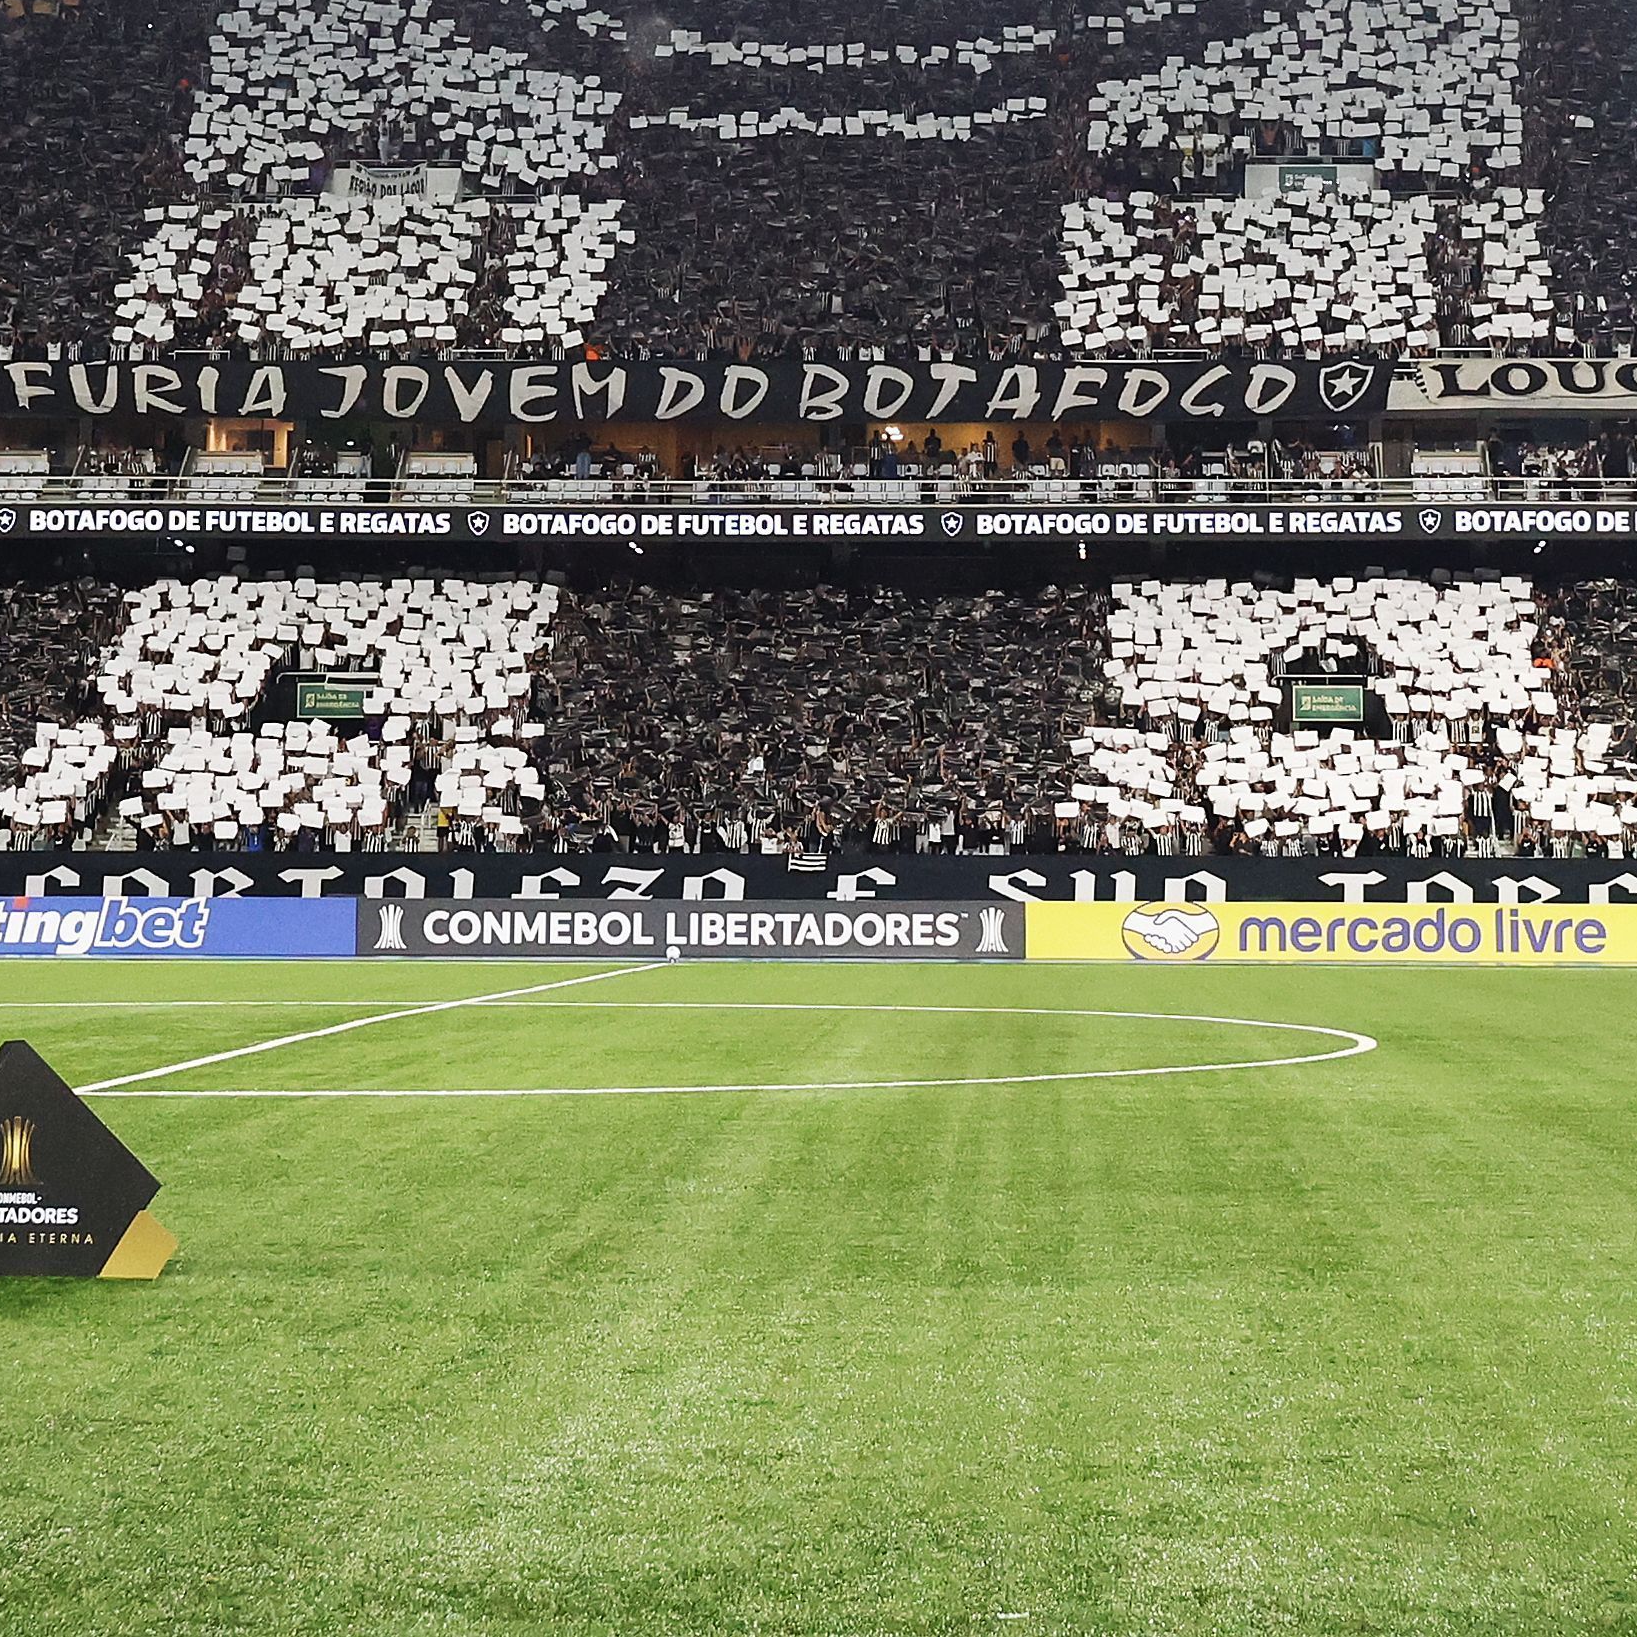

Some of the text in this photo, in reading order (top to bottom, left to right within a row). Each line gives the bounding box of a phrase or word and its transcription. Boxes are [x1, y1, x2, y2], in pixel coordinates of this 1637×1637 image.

[318, 364, 628, 423] JOVEM
[653, 366, 769, 422] DO
[29, 510, 451, 534] BOTAFOGO DE FUTEBOL E REGATAS
[503, 514, 924, 536] BOTAFOGO DE FUTEBOL E REGATAS
[976, 512, 1402, 535] BOTAFOGO DE FUTEBOL E REGATAS
[1455, 511, 1592, 532] BOTAFOGO
[1596, 511, 1630, 532] DE
[422, 909, 960, 948] CONMEBOL LIBERTADORES
[1238, 908, 1607, 954] mercado livre
[28, 1232, 94, 1245] ETERNA
